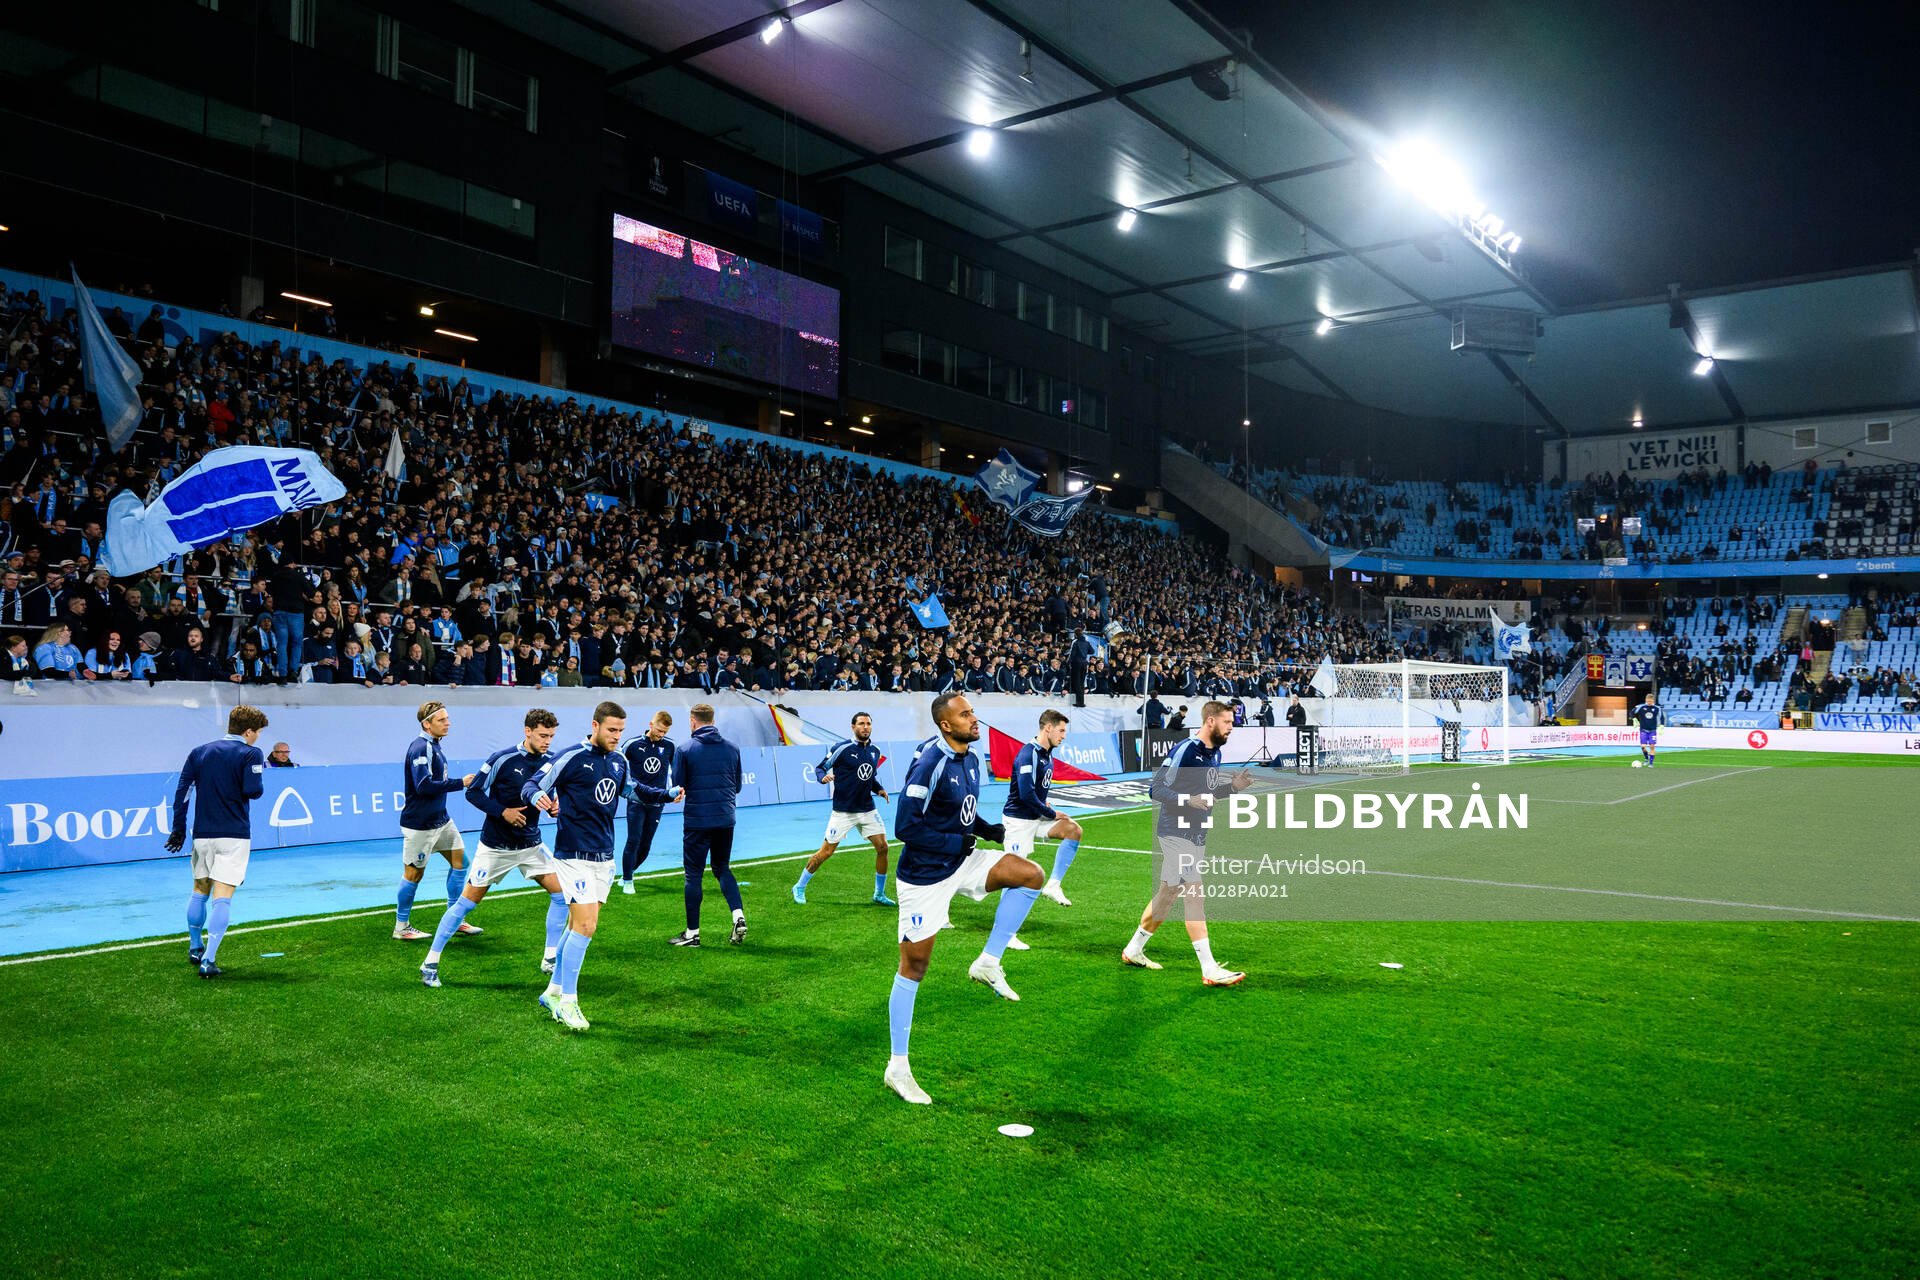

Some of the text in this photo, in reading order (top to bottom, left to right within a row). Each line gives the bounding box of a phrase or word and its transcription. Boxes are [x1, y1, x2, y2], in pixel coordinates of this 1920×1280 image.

[714, 191, 751, 216] UEFA
[1629, 439, 1669, 456] VET
[1627, 450, 1718, 471] LEWICKI
[1407, 604, 1441, 618] TRAS
[1074, 745, 1106, 764] bemt
[1300, 730, 1311, 774] SELECT
[7, 795, 173, 847] Boozt
